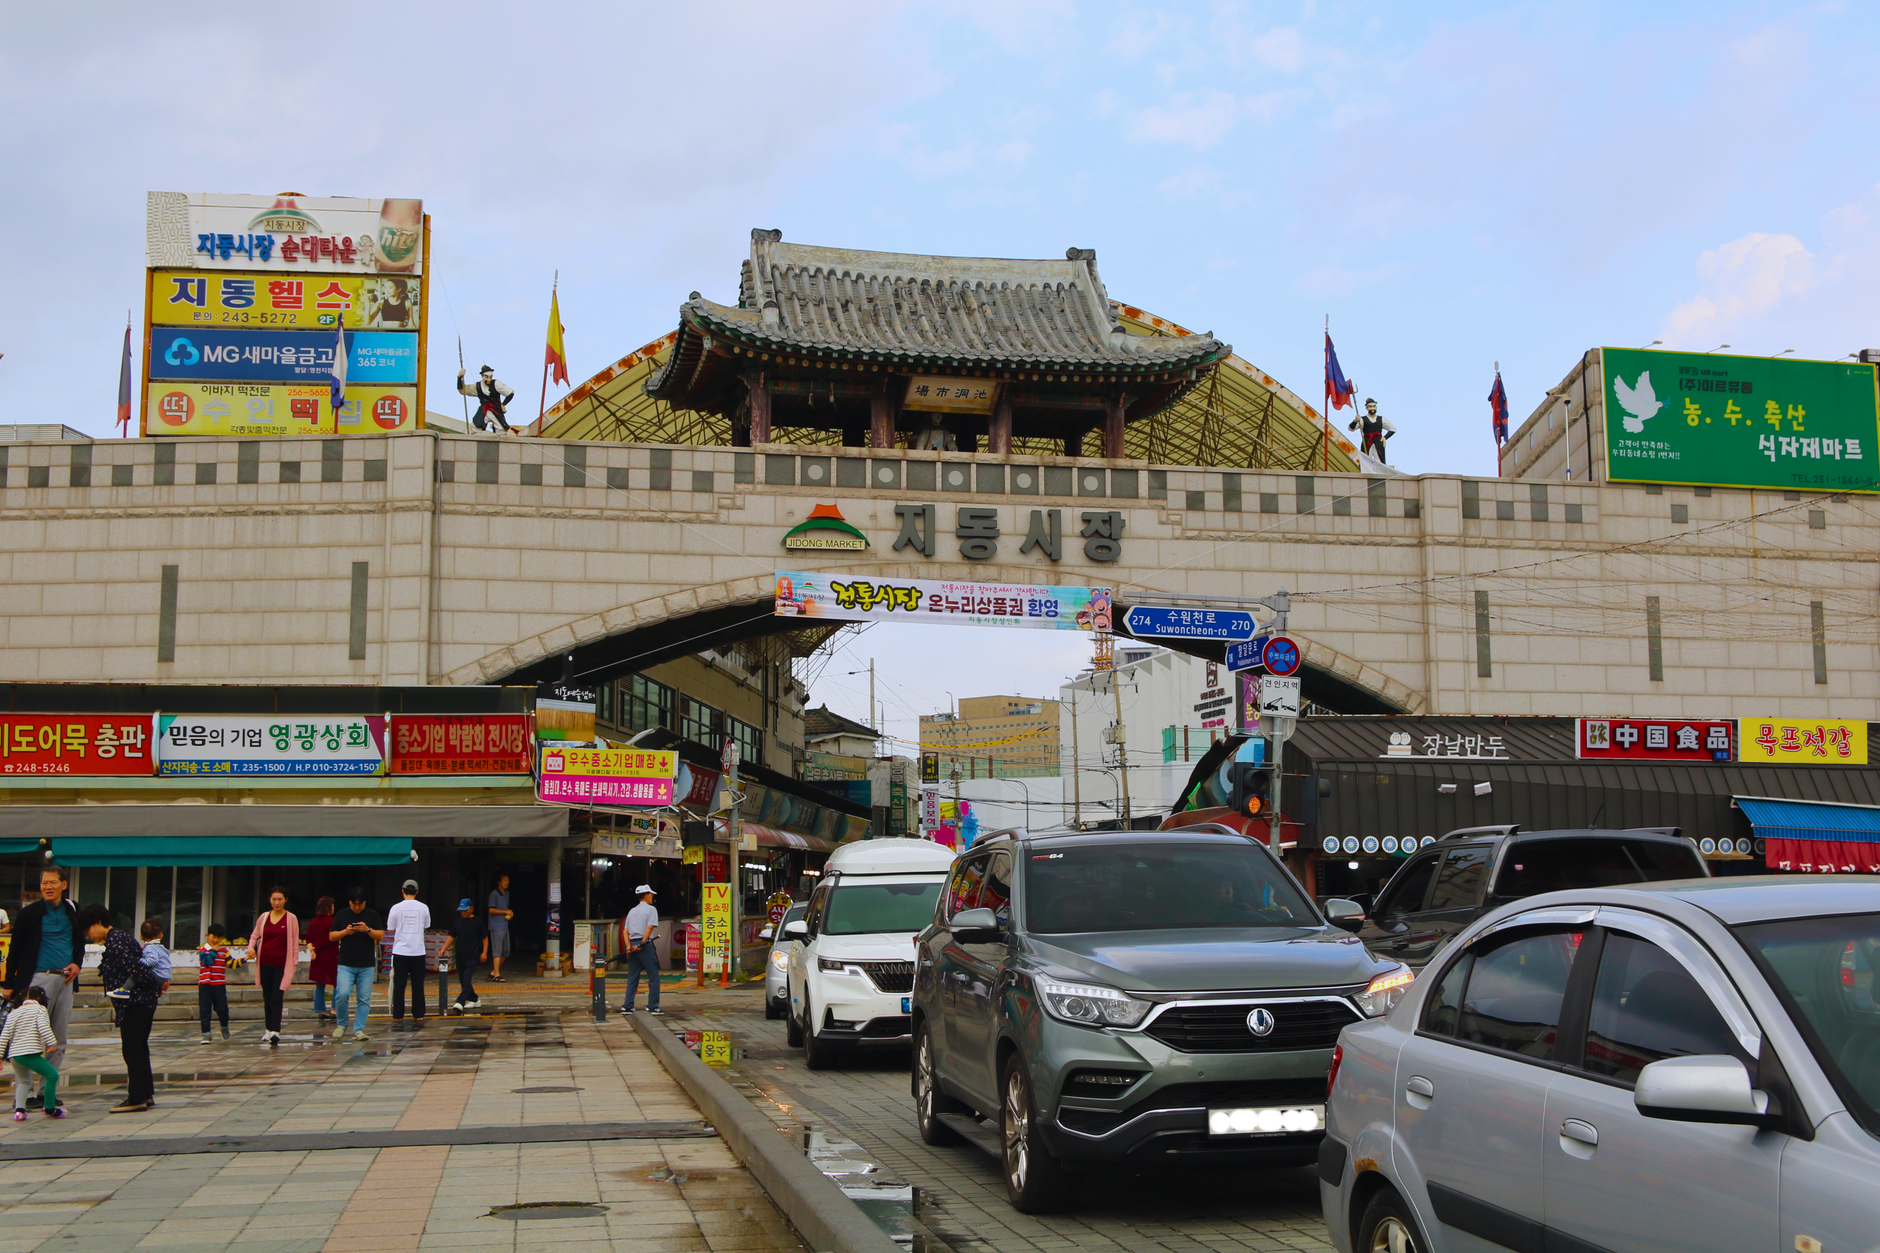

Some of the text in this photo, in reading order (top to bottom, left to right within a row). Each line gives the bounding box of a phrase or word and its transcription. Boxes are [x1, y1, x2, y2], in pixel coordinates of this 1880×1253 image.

[264, 220, 306, 231] 지동시장
[197, 233, 356, 263] 지동시장 순대타운
[222, 312, 297, 324] 243-5272
[319, 315, 334, 324] 2F
[204, 346, 334, 365] MG 새마을금고
[358, 358, 395, 367] 365 코너
[202, 386, 270, 396] 이바지 떡전문
[163, 396, 194, 423] 떡
[377, 400, 400, 426] 떡
[1618, 439, 1671, 450] 고객이 만족하는
[1759, 434, 1863, 462] 식자재마트
[1791, 474, 1810, 483] TEL
[893, 503, 1126, 561] 지동시장
[788, 538, 864, 549] JIDONG MARKET
[830, 580, 922, 612] 전통시장
[928, 594, 1058, 618] 온누리상품권 환영
[968, 617, 1021, 625] 지동시장상인회
[1132, 616, 1151, 626] 274
[1167, 611, 1217, 625] 수원천로
[1156, 623, 1228, 636] Suwoncheon-ro
[1231, 620, 1250, 631] 270
[1264, 679, 1298, 690] 견인지역
[554, 687, 596, 701] 지동예술샘터
[94, 724, 145, 758] 총판
[169, 723, 370, 751] 믿음의 기업 영광상회
[397, 724, 524, 753] 중소기업 박람회 전시장
[1755, 724, 1853, 757] 목포젓갈
[1422, 733, 1506, 757] 장날만두
[569, 753, 656, 769] 우수중소기업매장
[16, 763, 70, 773] 248-5246
[213, 762, 230, 773] 소매
[242, 764, 285, 772] 235-1500
[296, 764, 311, 772] H.P
[312, 763, 380, 772] 010-3724-1501
[704, 886, 730, 898] TV
[704, 903, 729, 912] 홈쇼핑
[705, 917, 727, 929] 중소
[706, 931, 727, 943] 기업
